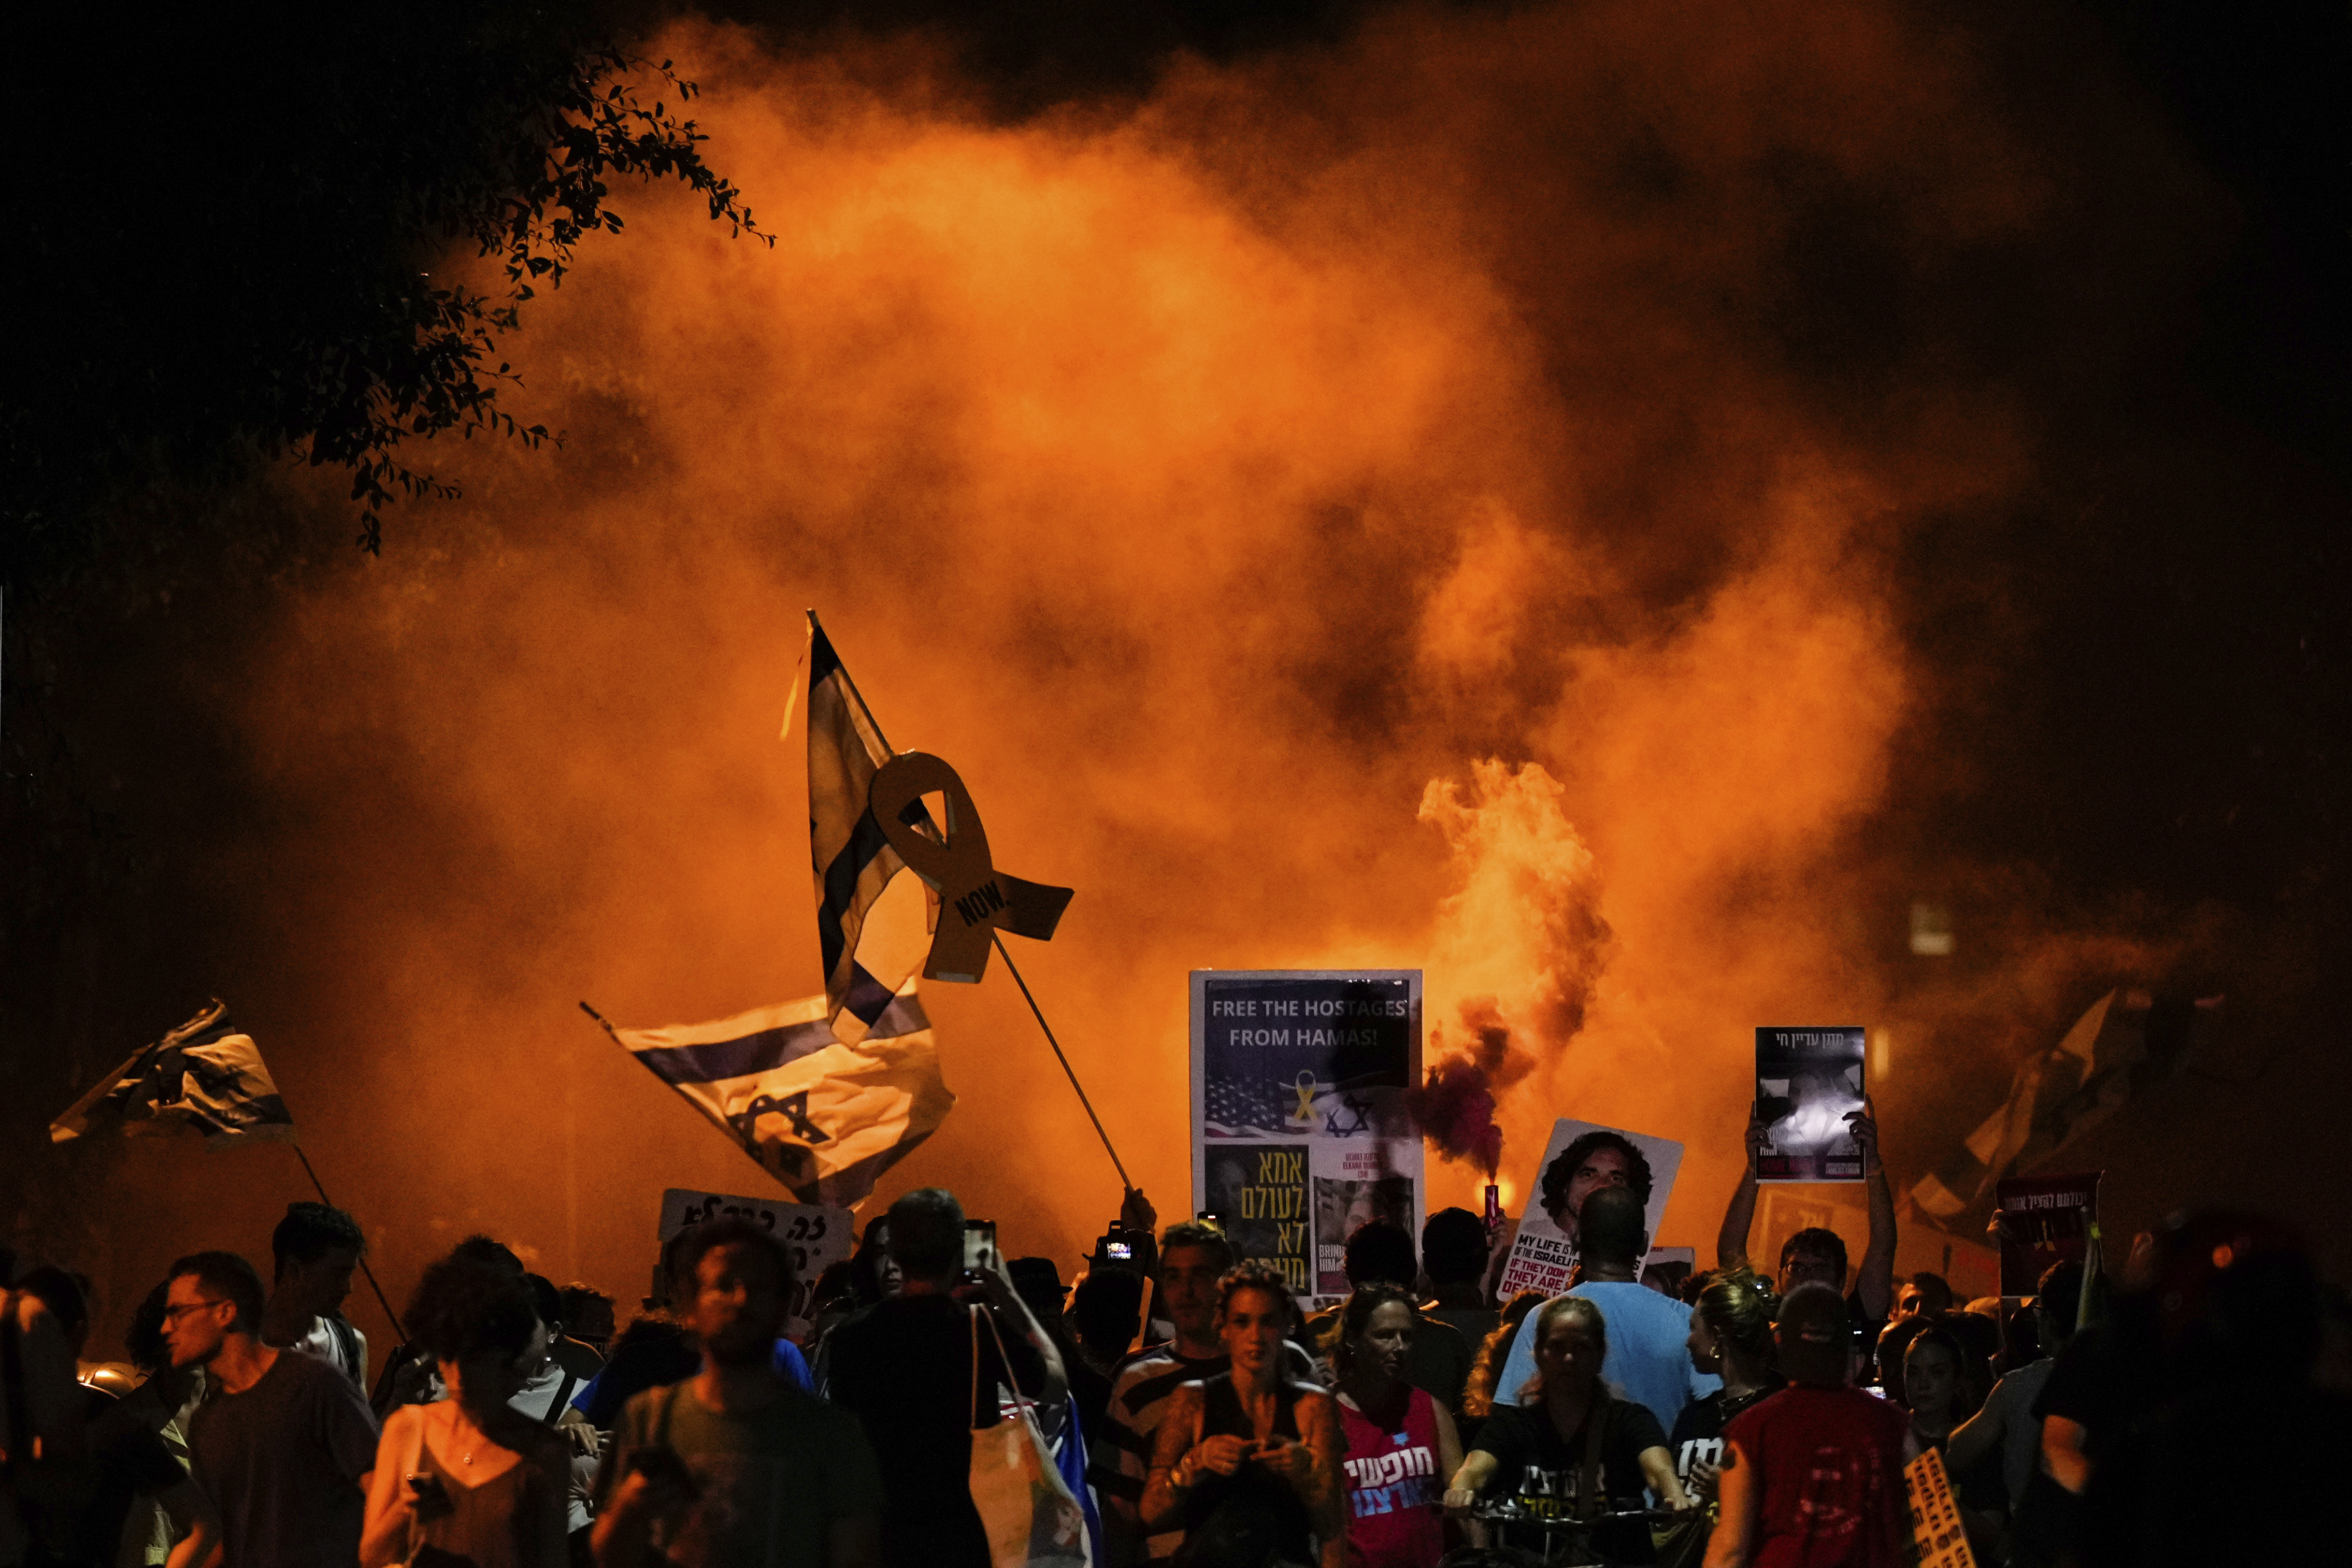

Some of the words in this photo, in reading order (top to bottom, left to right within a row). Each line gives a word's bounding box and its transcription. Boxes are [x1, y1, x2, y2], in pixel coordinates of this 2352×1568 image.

[1213, 1000, 1257, 1017] FREE
[1262, 1000, 1299, 1017] THE
[1305, 1000, 1406, 1017] HOSTAGES
[1230, 1029, 1289, 1046] FROM
[1297, 1029, 1378, 1046] HAMAS!
[1775, 1033, 1789, 1046] חי
[1791, 1033, 1819, 1049] עדיין
[1822, 1033, 1844, 1049] מתן
[1259, 1152, 1303, 1184] אמא
[1241, 1185, 1303, 1219] לעולם
[1277, 1220, 1303, 1254] לא
[1518, 1234, 1536, 1246] MY
[1537, 1238, 1562, 1253] LIFE
[1562, 1244, 1570, 1255] IS
[1320, 1258, 1336, 1272] HIM
[1510, 1258, 1521, 1268] IF
[1522, 1261, 1546, 1274] THEY
[1514, 1246, 1522, 1255] OF
[1523, 1248, 1534, 1258] THE
[1533, 1250, 1571, 1267] ISRAELI
[1509, 1269, 1537, 1284] THEY
[1538, 1276, 1564, 1290] ARE
[1343, 1446, 1435, 1488] חופשי
